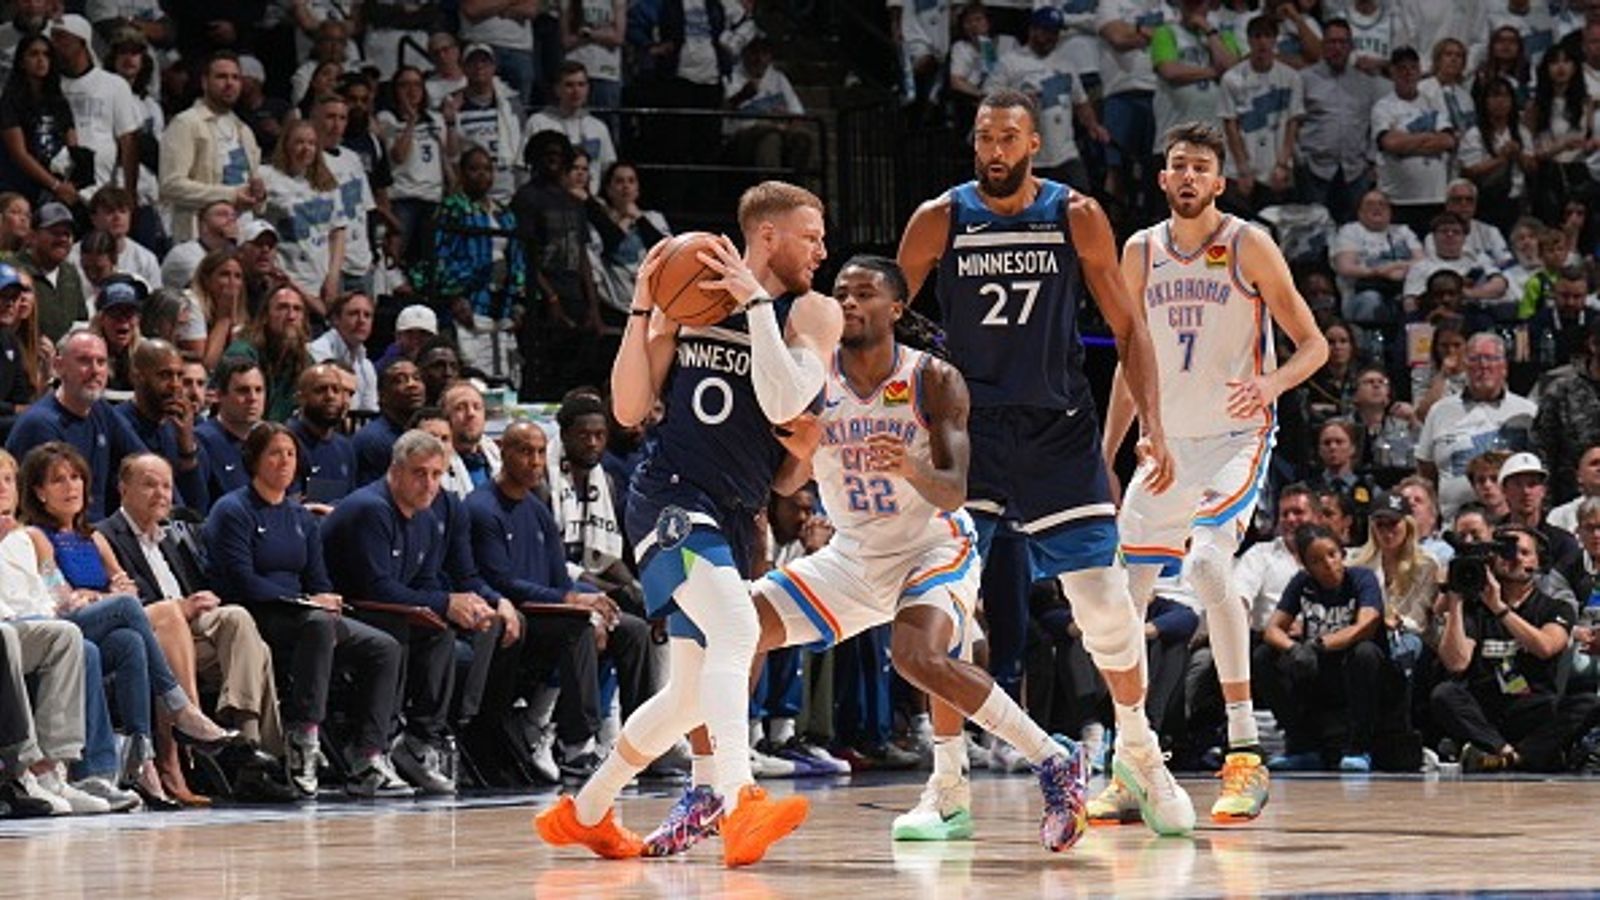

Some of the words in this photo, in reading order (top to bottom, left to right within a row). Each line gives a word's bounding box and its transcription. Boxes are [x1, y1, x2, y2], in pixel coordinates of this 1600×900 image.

[421, 144, 432, 162] 3
[958, 250, 1059, 277] MINNESOTA
[979, 280, 1041, 325] 27
[1147, 278, 1232, 308] OKLAHOMA
[1168, 305, 1204, 328] CITY
[1177, 330, 1197, 372] 7
[692, 377, 734, 425] 0
[844, 475, 899, 514] 22
